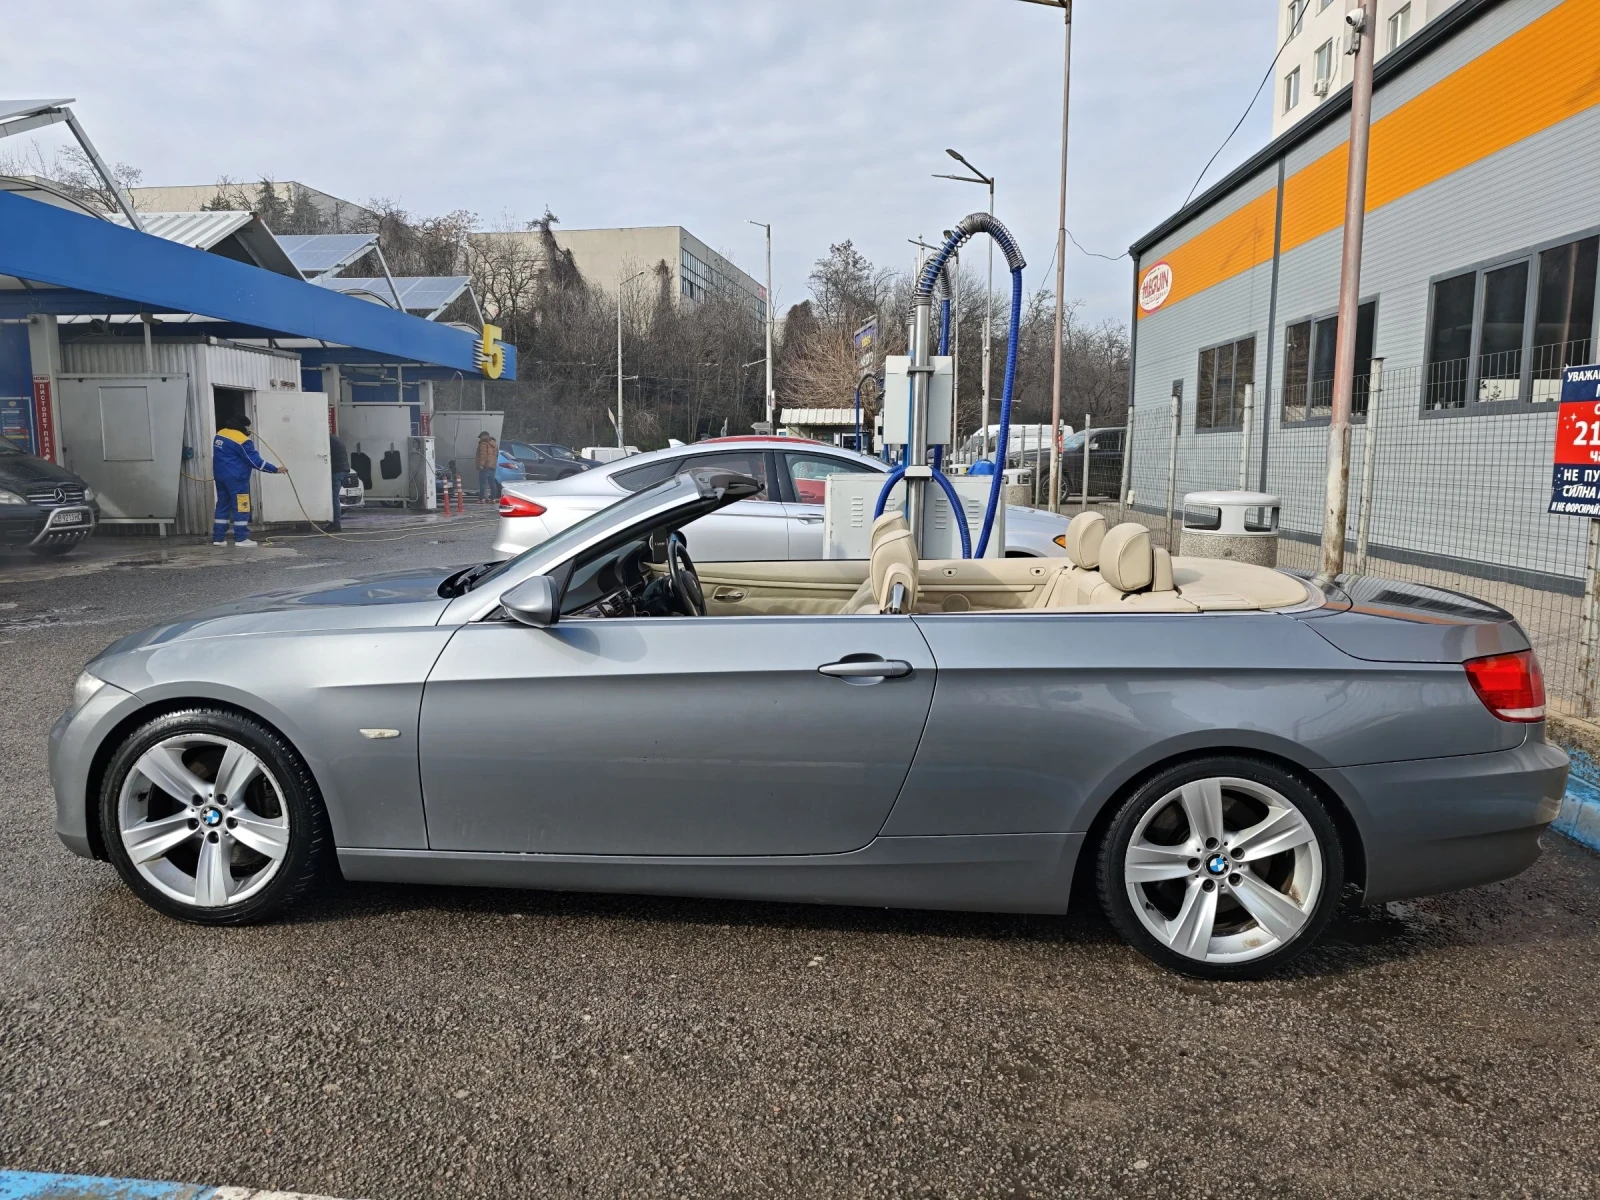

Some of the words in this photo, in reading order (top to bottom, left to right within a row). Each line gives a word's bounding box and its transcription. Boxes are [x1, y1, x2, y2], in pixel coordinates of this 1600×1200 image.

[482, 323, 503, 380] 5
[1567, 369, 1600, 382] УВАЖА
[1573, 421, 1600, 446] 21
[1563, 469, 1579, 481] НЕ
[1584, 470, 1600, 482] ПУ
[1562, 485, 1597, 499] СИЛНА
[1556, 502, 1566, 512] НЕ
